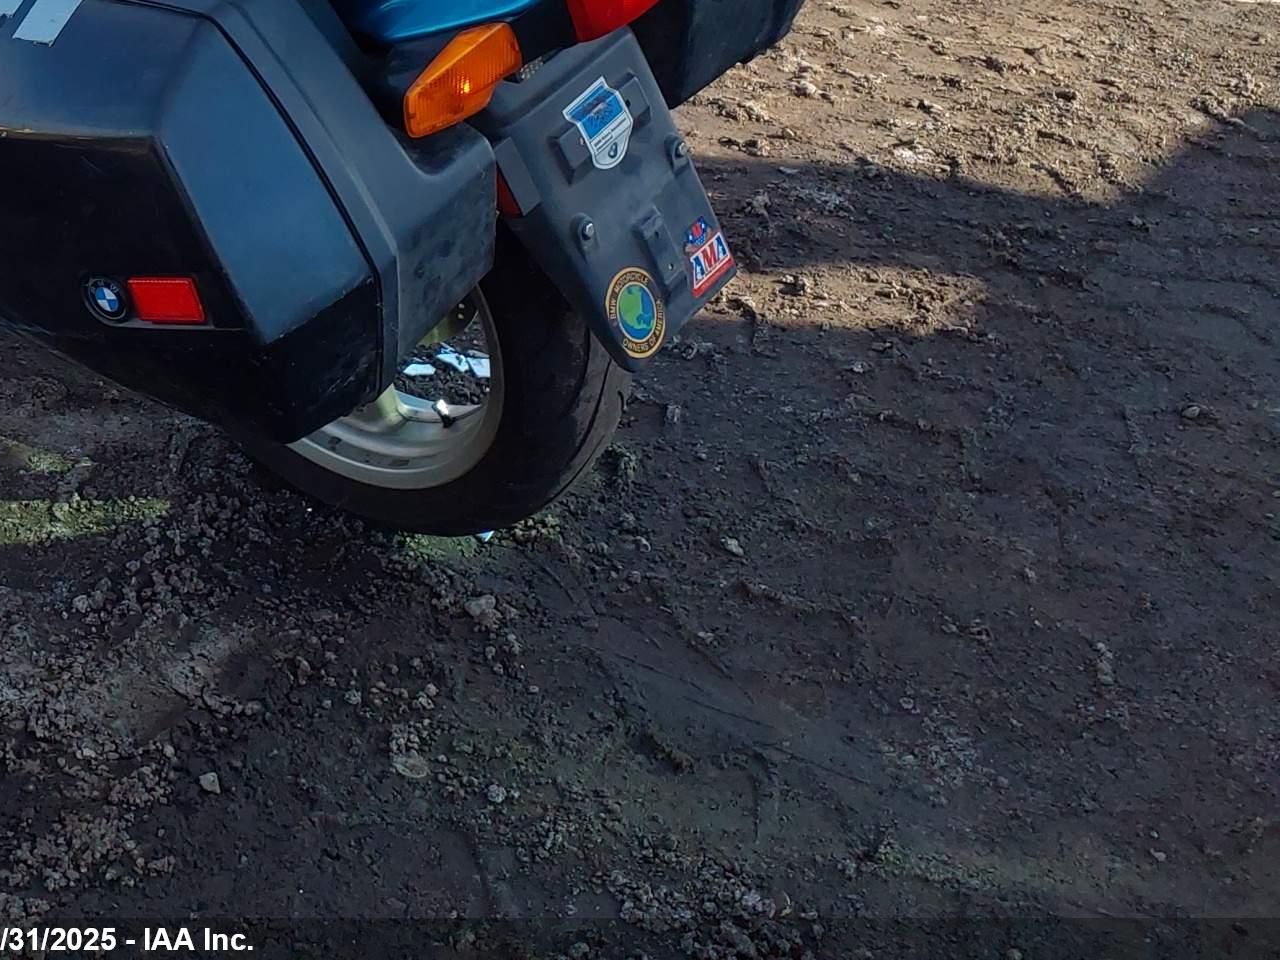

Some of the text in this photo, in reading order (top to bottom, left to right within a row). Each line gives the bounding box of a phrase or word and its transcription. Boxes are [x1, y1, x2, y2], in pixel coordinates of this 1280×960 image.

[692, 234, 729, 283] AMA
[614, 272, 650, 293] MOTORCYCLE
[609, 297, 617, 320] BMW
[622, 338, 649, 352] OWNERS
